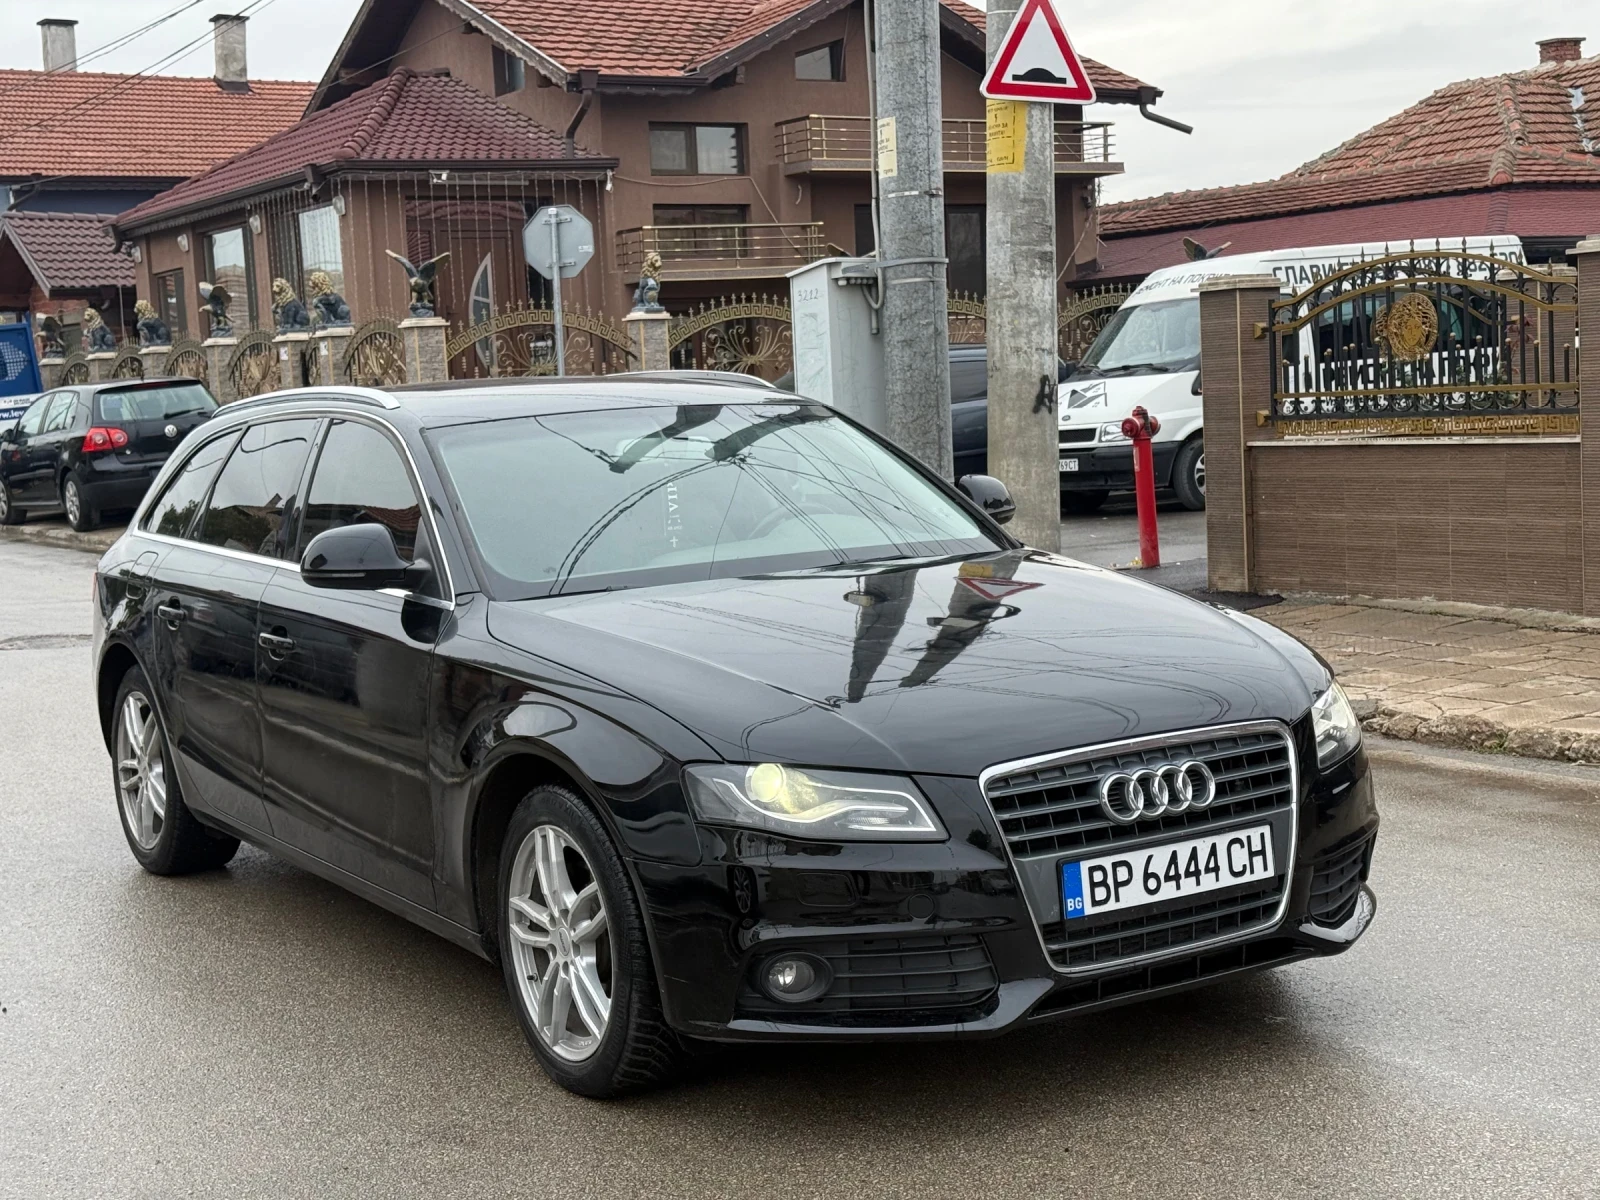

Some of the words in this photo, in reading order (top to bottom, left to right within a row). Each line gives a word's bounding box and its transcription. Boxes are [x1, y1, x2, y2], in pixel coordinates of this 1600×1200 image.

[1088, 859, 1133, 907] BP
[1142, 842, 1220, 896] 6444
[1226, 832, 1269, 878] CH
[1067, 897, 1082, 911] BG
